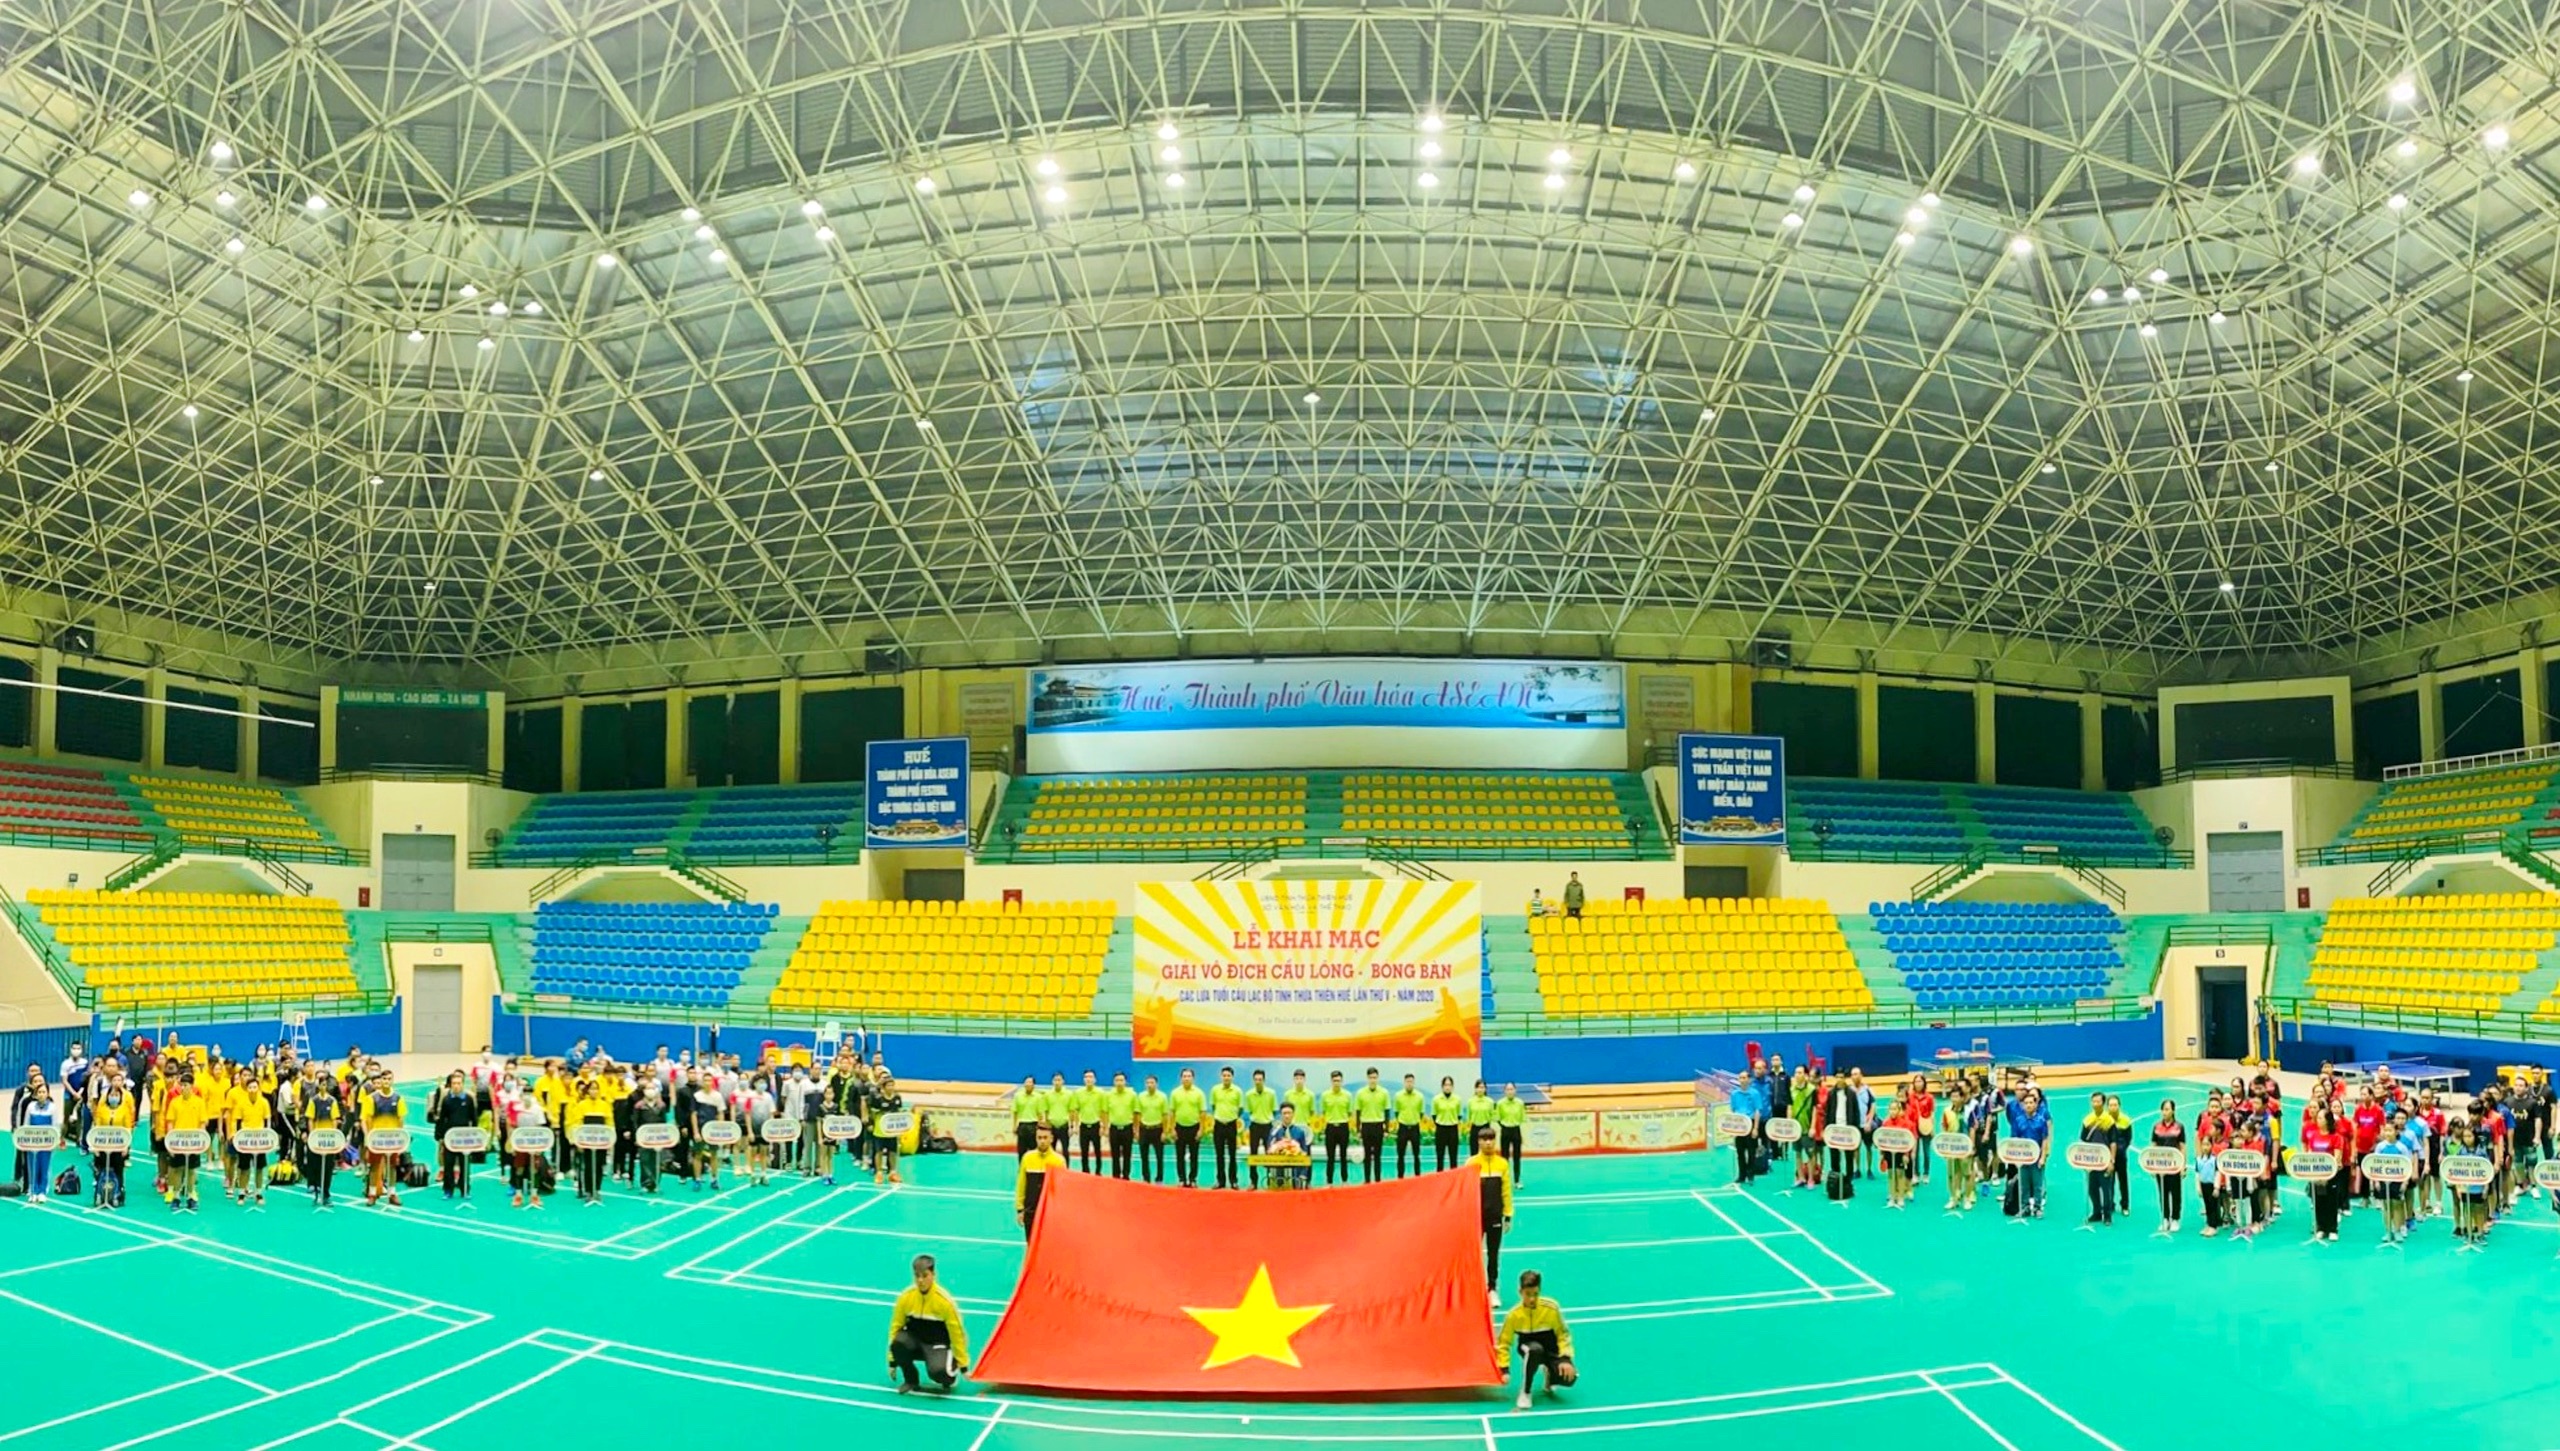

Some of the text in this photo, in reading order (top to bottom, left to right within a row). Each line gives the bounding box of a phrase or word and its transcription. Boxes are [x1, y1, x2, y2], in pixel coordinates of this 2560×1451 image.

[1185, 682, 1256, 710] Thành
[1265, 681, 1310, 714] phố
[1315, 679, 1366, 706] Văn
[1421, 680, 1533, 708] ASEAN
[904, 745, 931, 764] HUẾ
[1753, 749, 1772, 761] NAM
[1753, 764, 1772, 776] NAM
[1233, 922, 1381, 953] LỄ KHAI MẠC
[1227, 963, 1267, 982] ĐỊCH
[1416, 990, 1434, 1002] 2020
[2312, 1164, 2332, 1172] MINH
